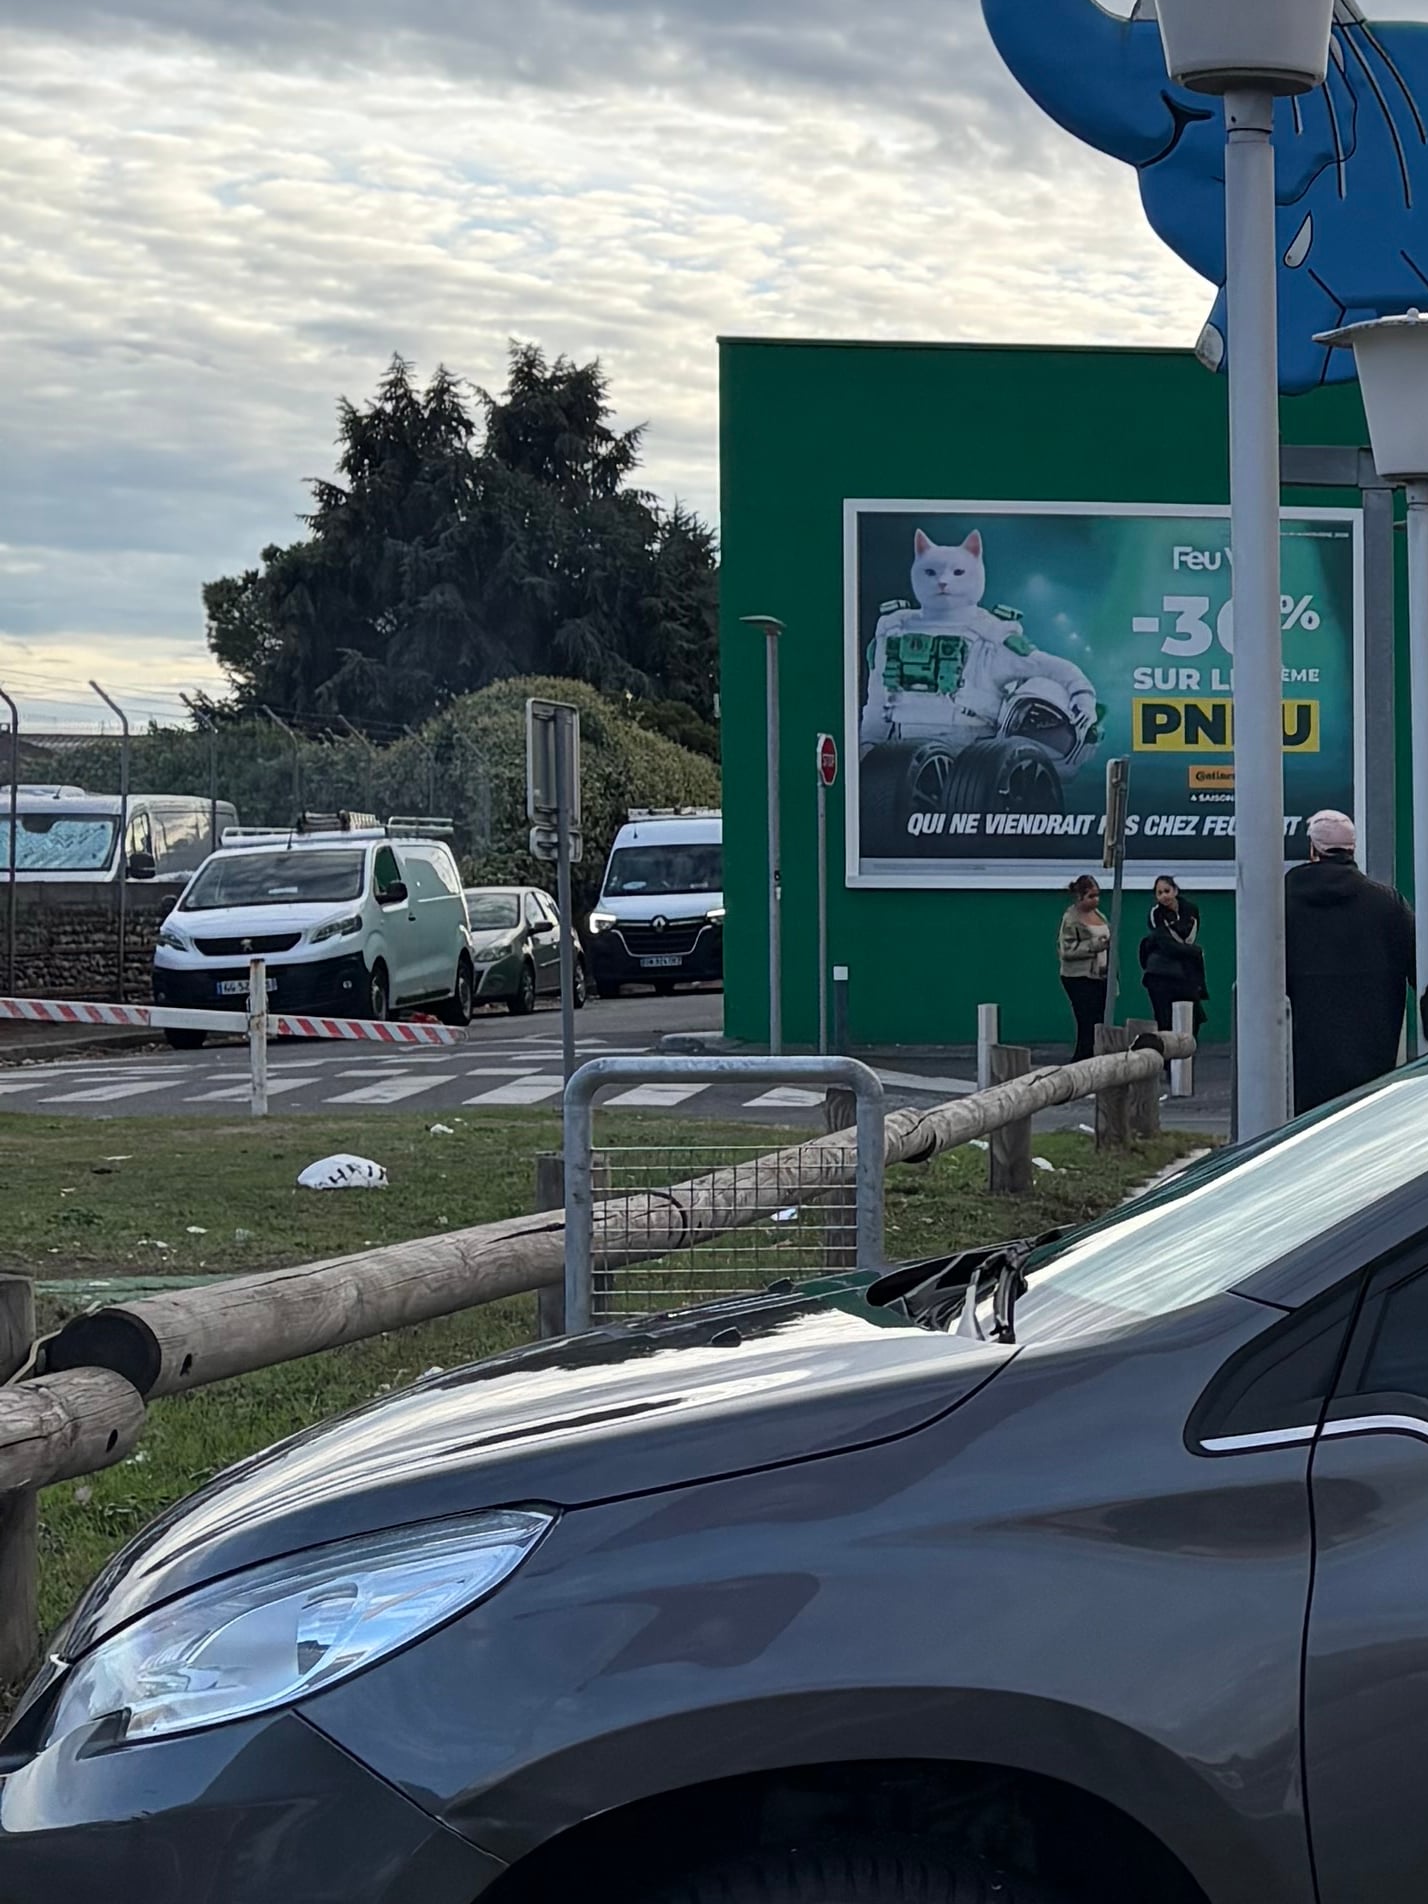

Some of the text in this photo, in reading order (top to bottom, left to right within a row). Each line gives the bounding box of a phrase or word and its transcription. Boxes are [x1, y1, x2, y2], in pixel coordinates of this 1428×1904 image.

[1173, 546, 1221, 571] Feu
[1133, 667, 1200, 691] SUR
[1211, 668, 1234, 692] L
[1142, 703, 1312, 746] PNU
[907, 813, 945, 836] QUI
[949, 814, 981, 834] NE
[985, 814, 1095, 835] VIENDRAIT
[1144, 815, 1200, 836] CHEZ
